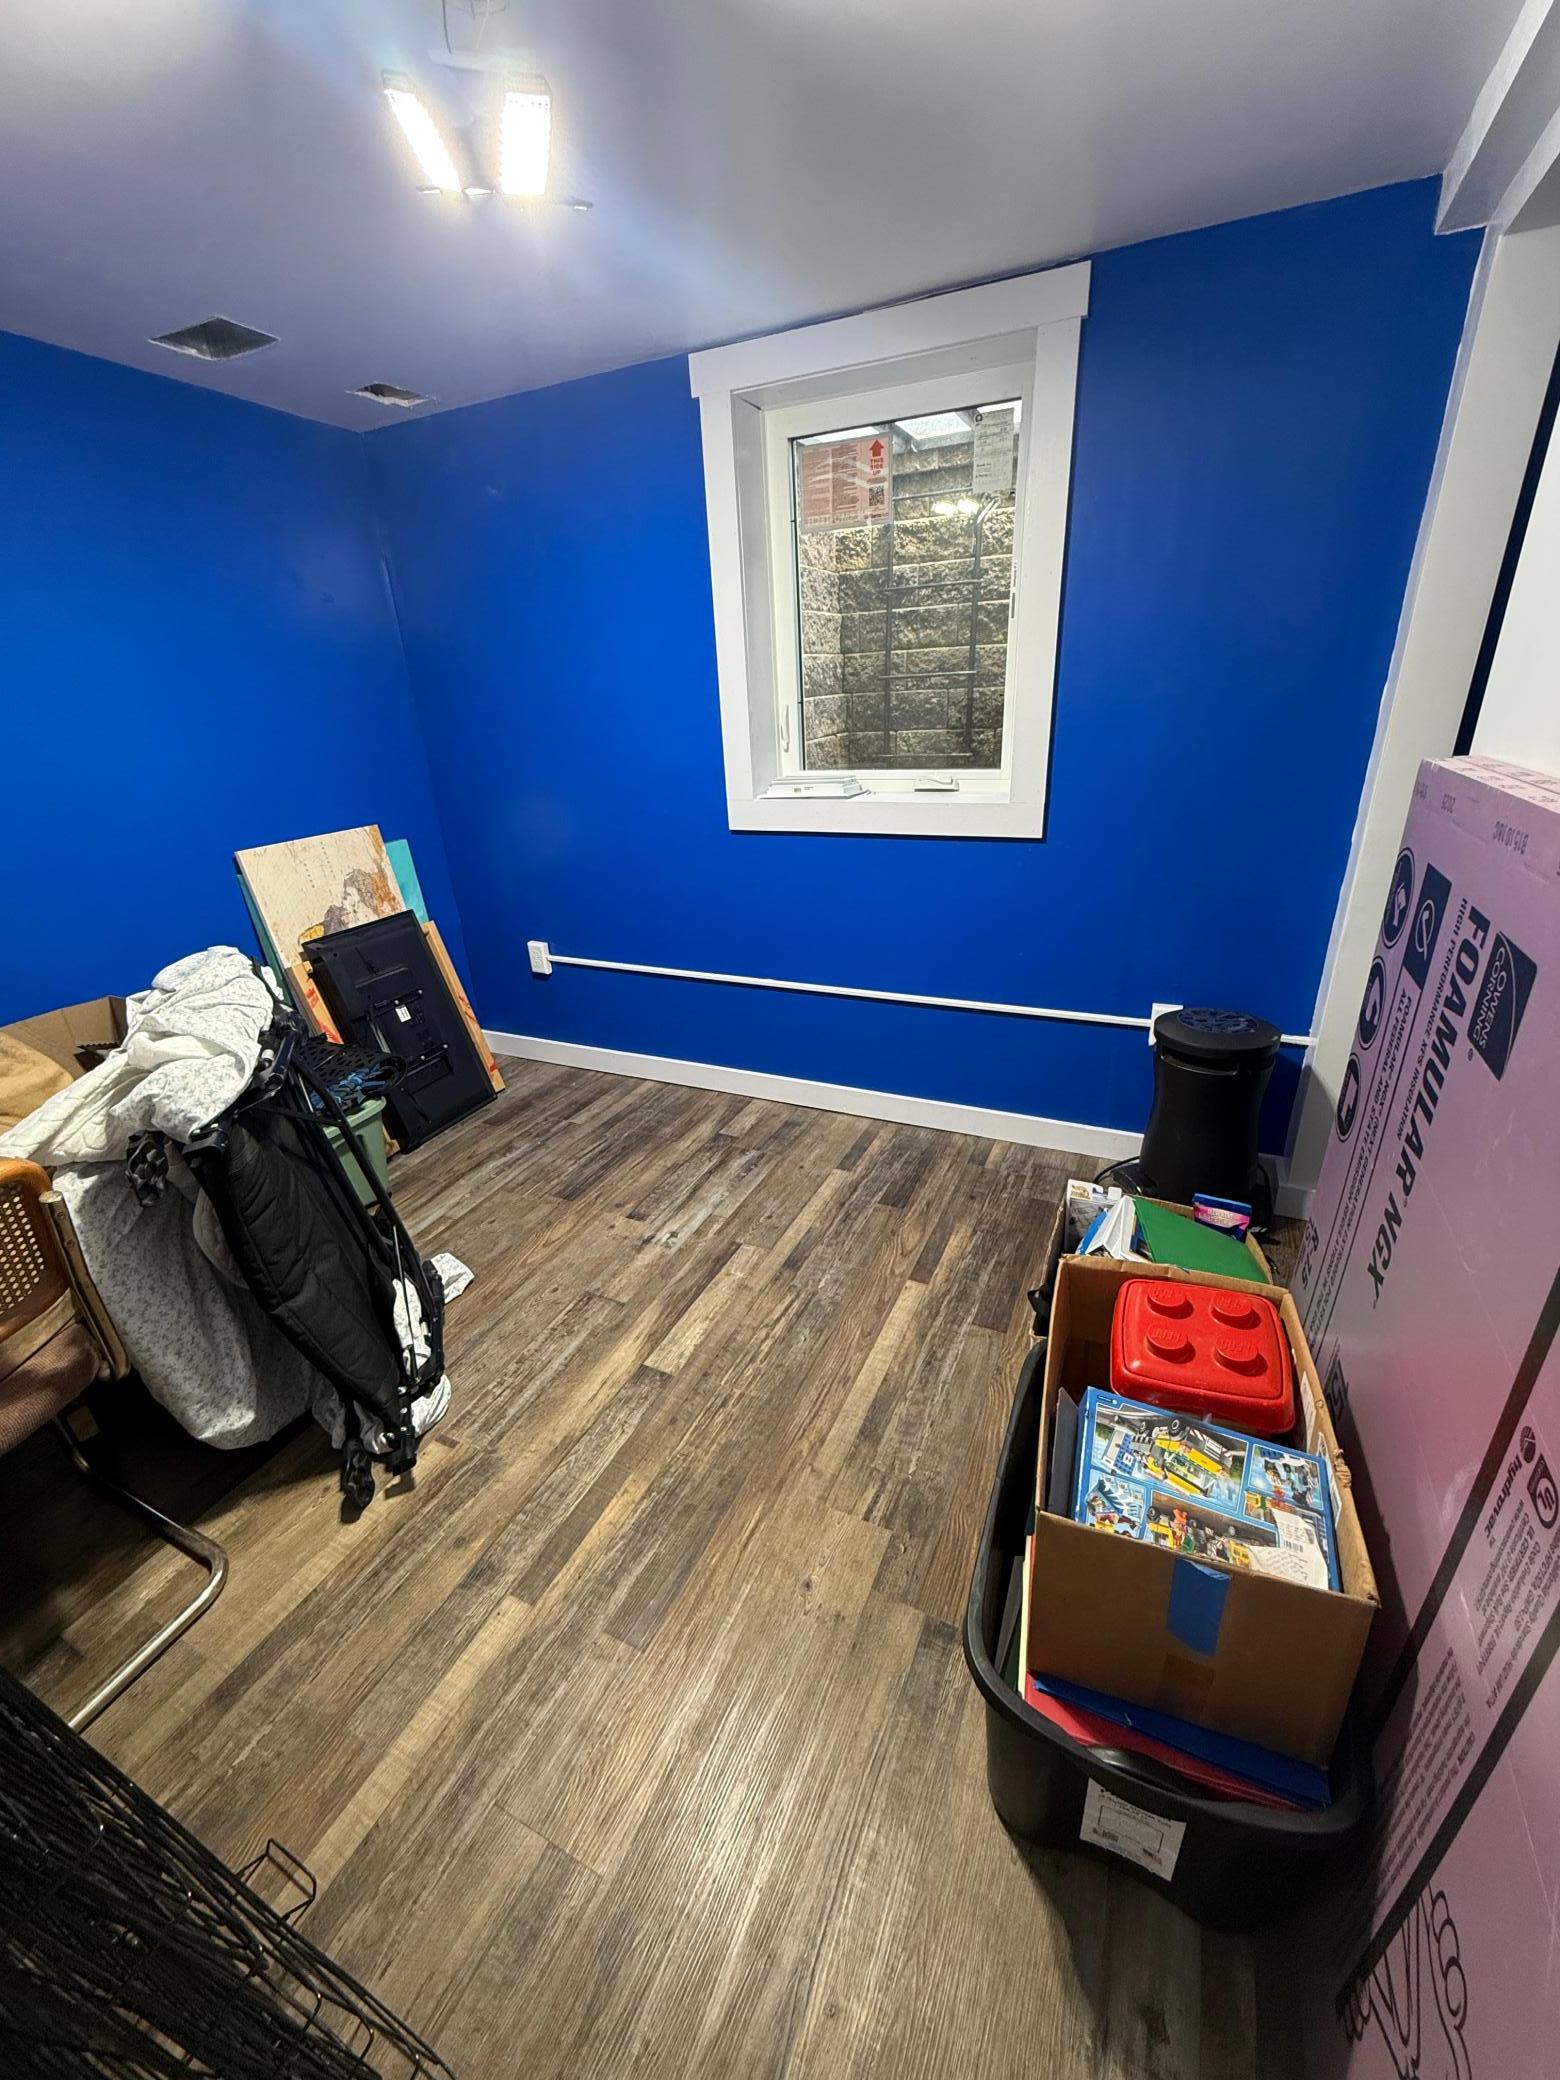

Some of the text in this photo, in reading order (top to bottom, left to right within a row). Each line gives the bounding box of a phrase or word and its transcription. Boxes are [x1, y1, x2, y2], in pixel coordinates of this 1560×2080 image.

[1396, 988, 1405, 1012] ALL
[1397, 898, 1467, 1139] HIGH PERFORMANCE XPS INSULATION
[1473, 947, 1504, 1039] CORNING
[1479, 971, 1506, 1047] OWENS
[1382, 1017, 1398, 1071] FEDERAL
[1374, 1076, 1382, 1103] AND
[1363, 1105, 1375, 1145] STATE
[1485, 1455, 1521, 1536] hydrovac
[1537, 1486, 1555, 1512] UL
